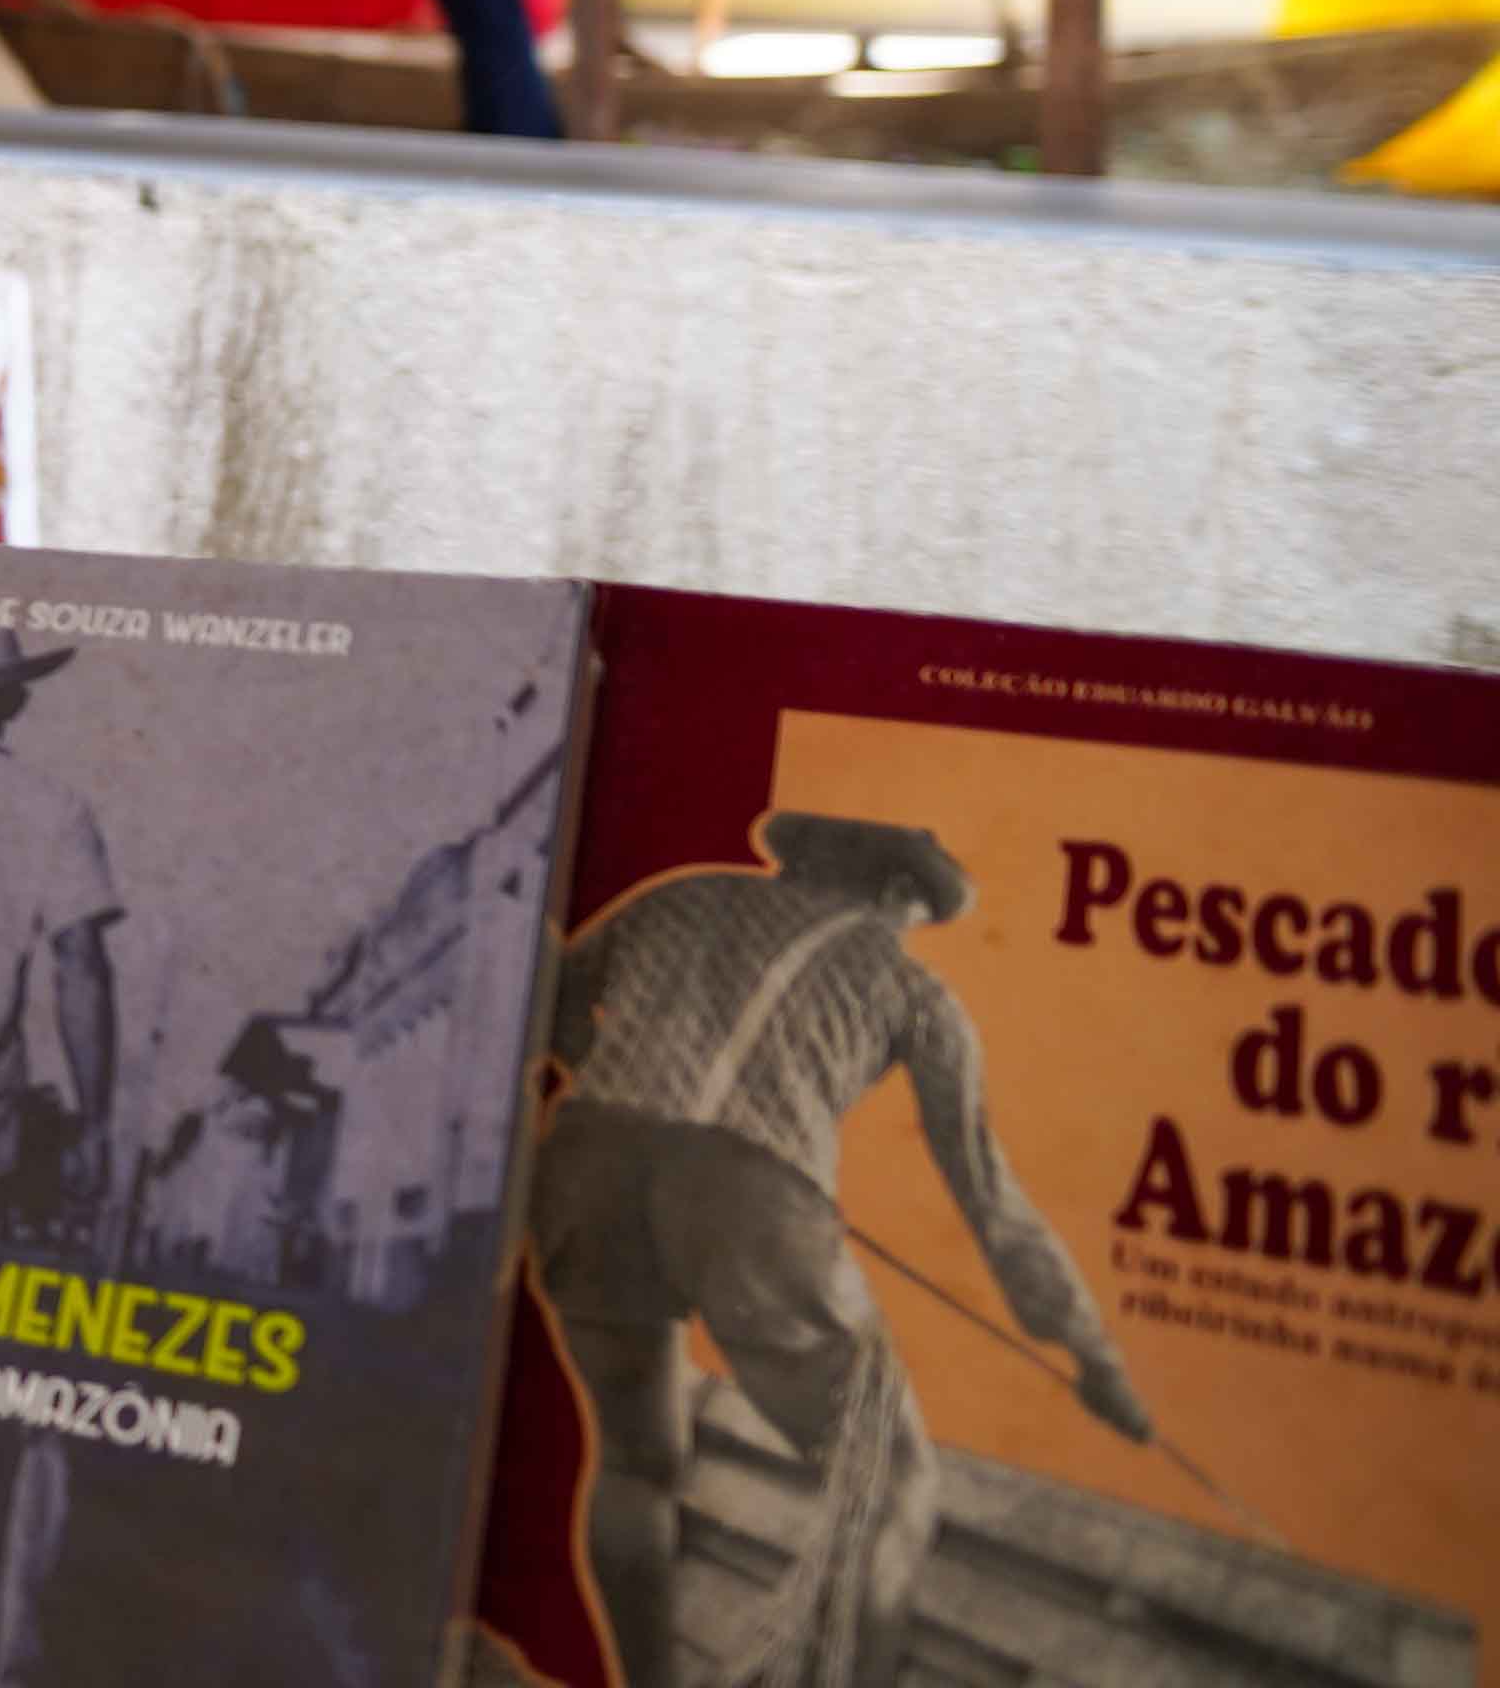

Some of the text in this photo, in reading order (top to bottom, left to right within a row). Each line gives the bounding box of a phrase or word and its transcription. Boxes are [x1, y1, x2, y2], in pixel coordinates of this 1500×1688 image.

[25, 601, 151, 642] SOUZA
[163, 613, 355, 656] WANZELER
[1231, 1003, 1384, 1129] do
[1113, 1114, 1500, 1300] Amaz
